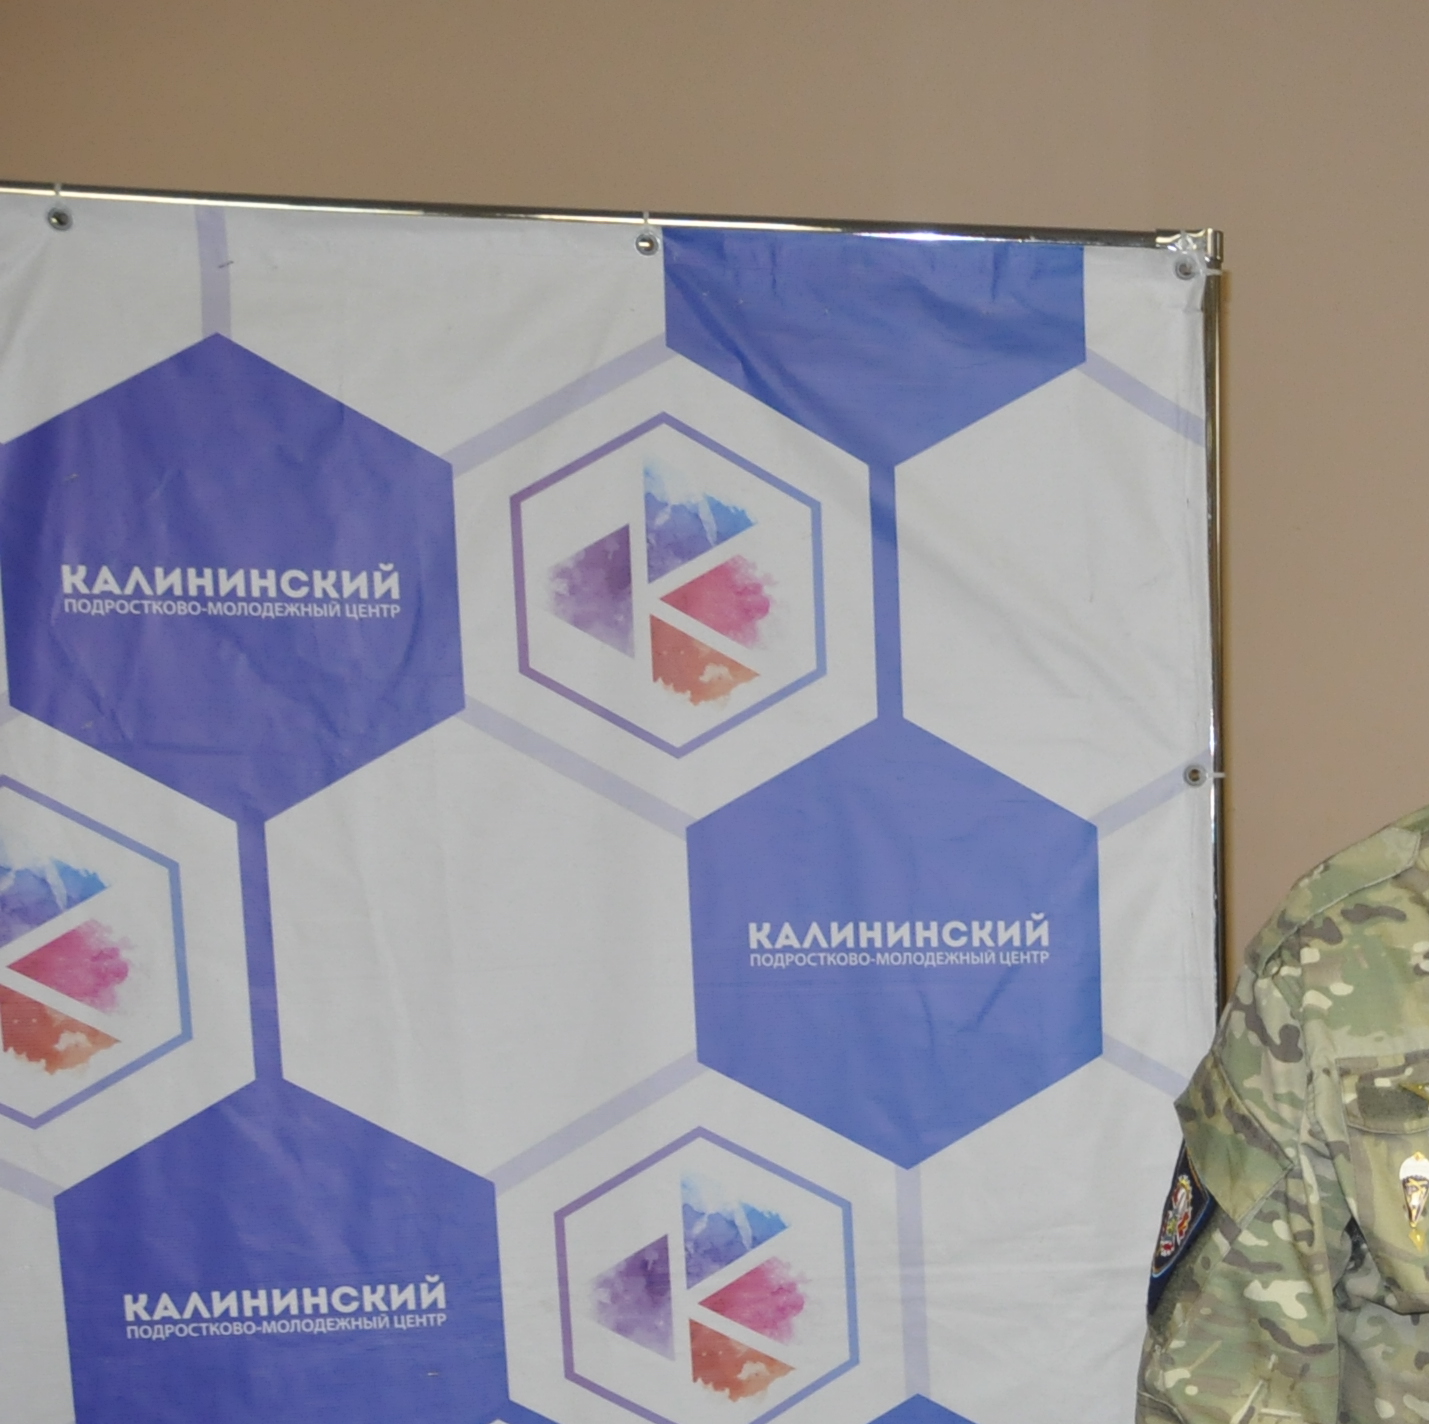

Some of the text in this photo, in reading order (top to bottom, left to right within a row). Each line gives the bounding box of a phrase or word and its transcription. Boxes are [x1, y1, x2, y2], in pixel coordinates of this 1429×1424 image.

[61, 563, 400, 599] КАЛИНИНСКИЙ
[64, 598, 401, 620] ПОДРОСТКОВО-МОЛОДЕЖНЫЙ ЦЕНТР
[749, 912, 1050, 949] КАЛИНИНСКИЙ
[750, 949, 1050, 968] ПОДРОСТКОВО-МОЛОДЕЖНЫЙ ЦЕНТР
[124, 1274, 447, 1322] КАЛИНИНСКИЙ
[127, 1313, 447, 1340] ПОДРОСТКОВО-МОЛОДЕЖНЫЙ ЦЕНТР
